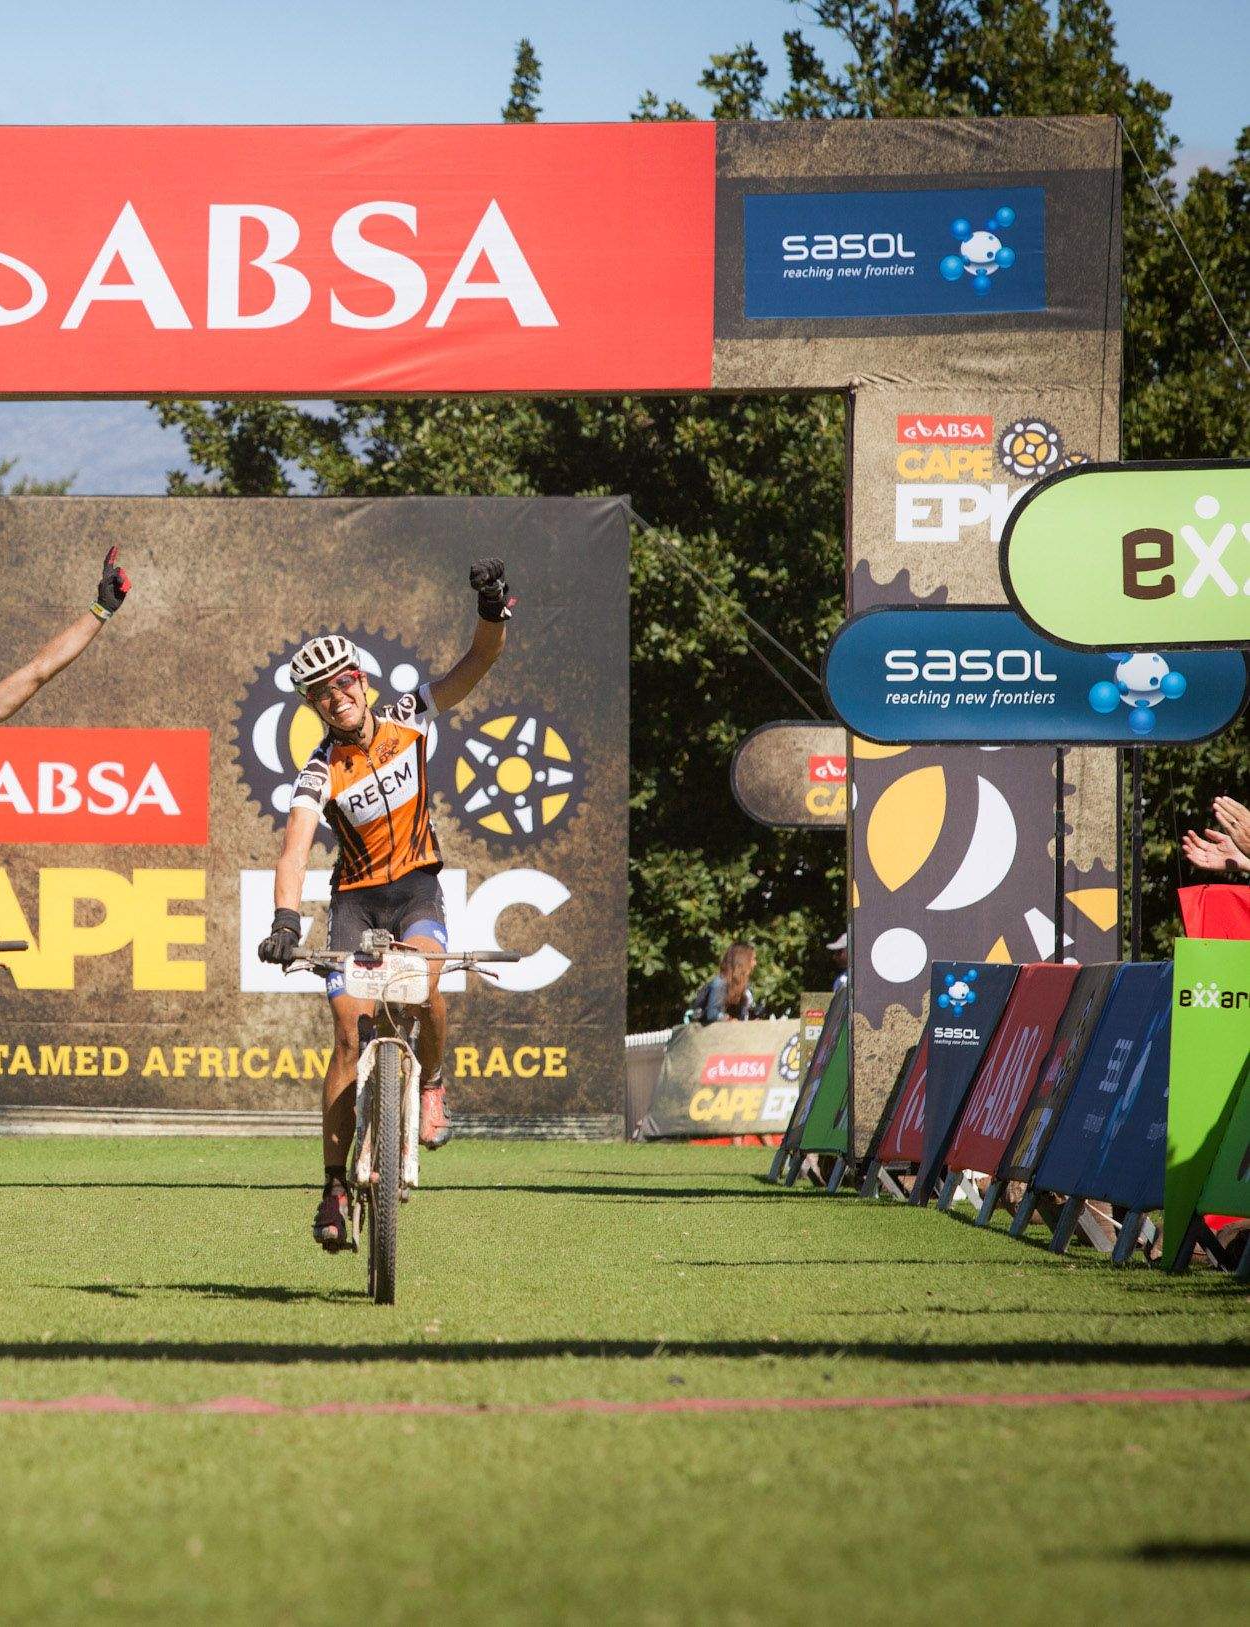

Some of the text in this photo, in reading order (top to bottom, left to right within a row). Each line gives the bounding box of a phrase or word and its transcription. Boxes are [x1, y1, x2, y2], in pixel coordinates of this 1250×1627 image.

[60, 198, 559, 329] ABSA
[783, 264, 915, 281] reaching new frontiers
[932, 423, 986, 438] ABSA
[896, 449, 993, 480] CAPE
[895, 483, 1034, 542] EPI
[1122, 495, 1250, 599] ex
[886, 690, 1056, 708] reaching new frontiers
[348, 761, 412, 813] RECM
[240, 868, 572, 992] EIC
[1179, 981, 1250, 1010] exxar
[141, 1045, 330, 1079] AFRICAN
[454, 1045, 568, 1078] RACE
[727, 1061, 766, 1078] ABSA
[688, 1087, 765, 1122] CAPE
